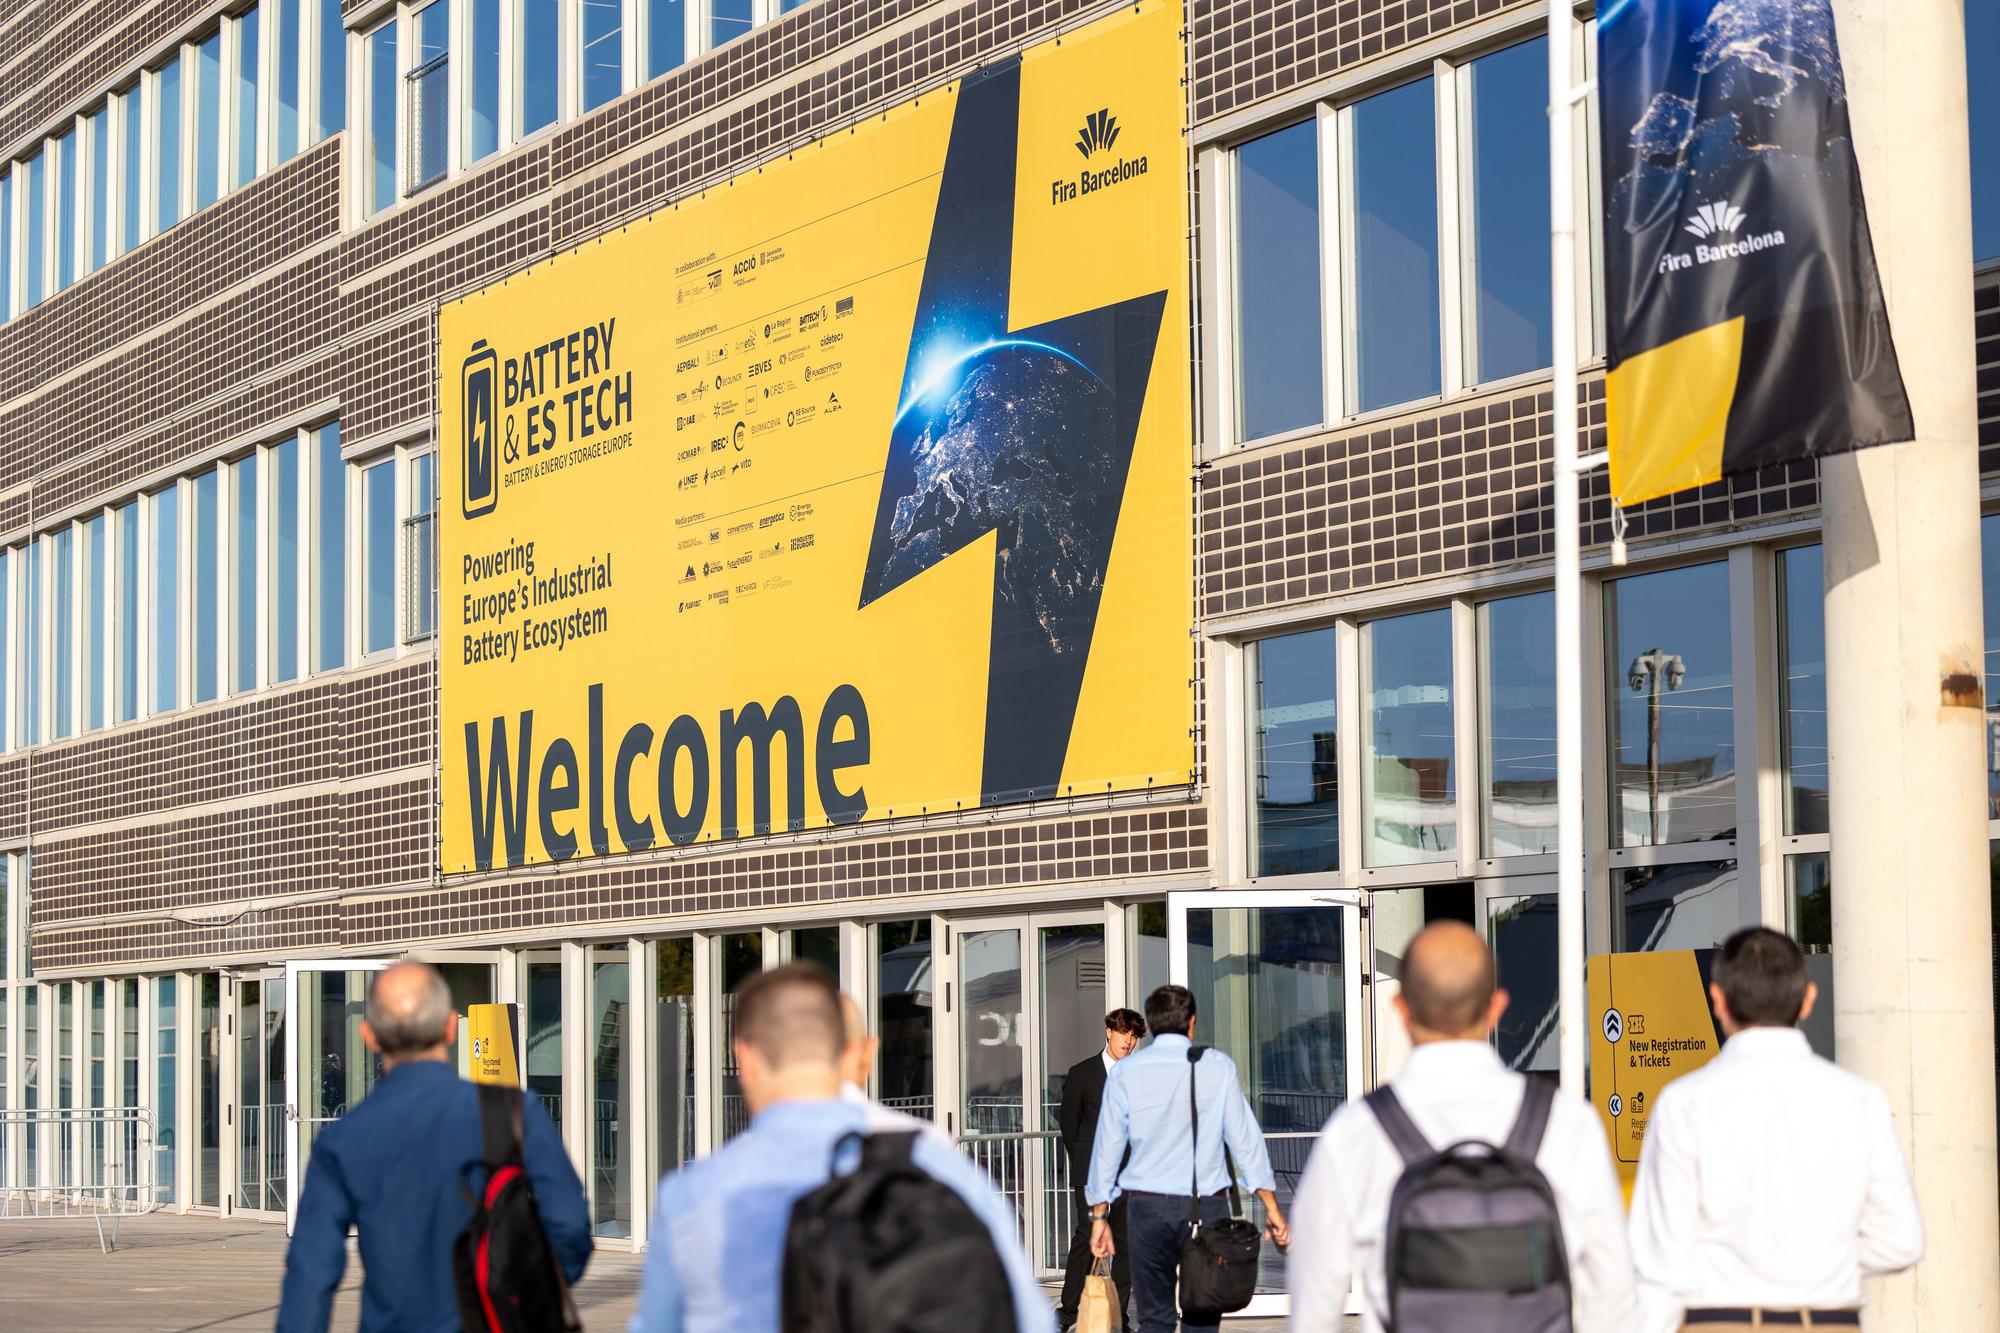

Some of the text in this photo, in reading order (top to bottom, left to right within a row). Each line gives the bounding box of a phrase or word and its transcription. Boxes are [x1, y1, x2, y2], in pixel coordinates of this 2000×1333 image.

[1052, 155, 1148, 205] Fira Barcelona
[733, 254, 757, 276] ACCIÓ
[1658, 229, 1786, 274] Fira Barcelona
[675, 328, 700, 345] Institutional
[505, 317, 616, 408] BATTERY
[754, 359, 772, 375] BVES
[504, 371, 632, 465] & ES TECH
[824, 404, 842, 415] ALBA
[505, 432, 633, 488] BATTERY & ENERGY STORAGE EUROPE
[683, 473, 698, 486] UNEF
[464, 538, 535, 584] Powering
[533, 553, 612, 606] Industrial
[464, 607, 607, 665] Battery Ecosystem
[464, 683, 871, 871] Welcome
[1629, 1037, 1706, 1055] New Registration
[1630, 1055, 1671, 1067] & Tickets
